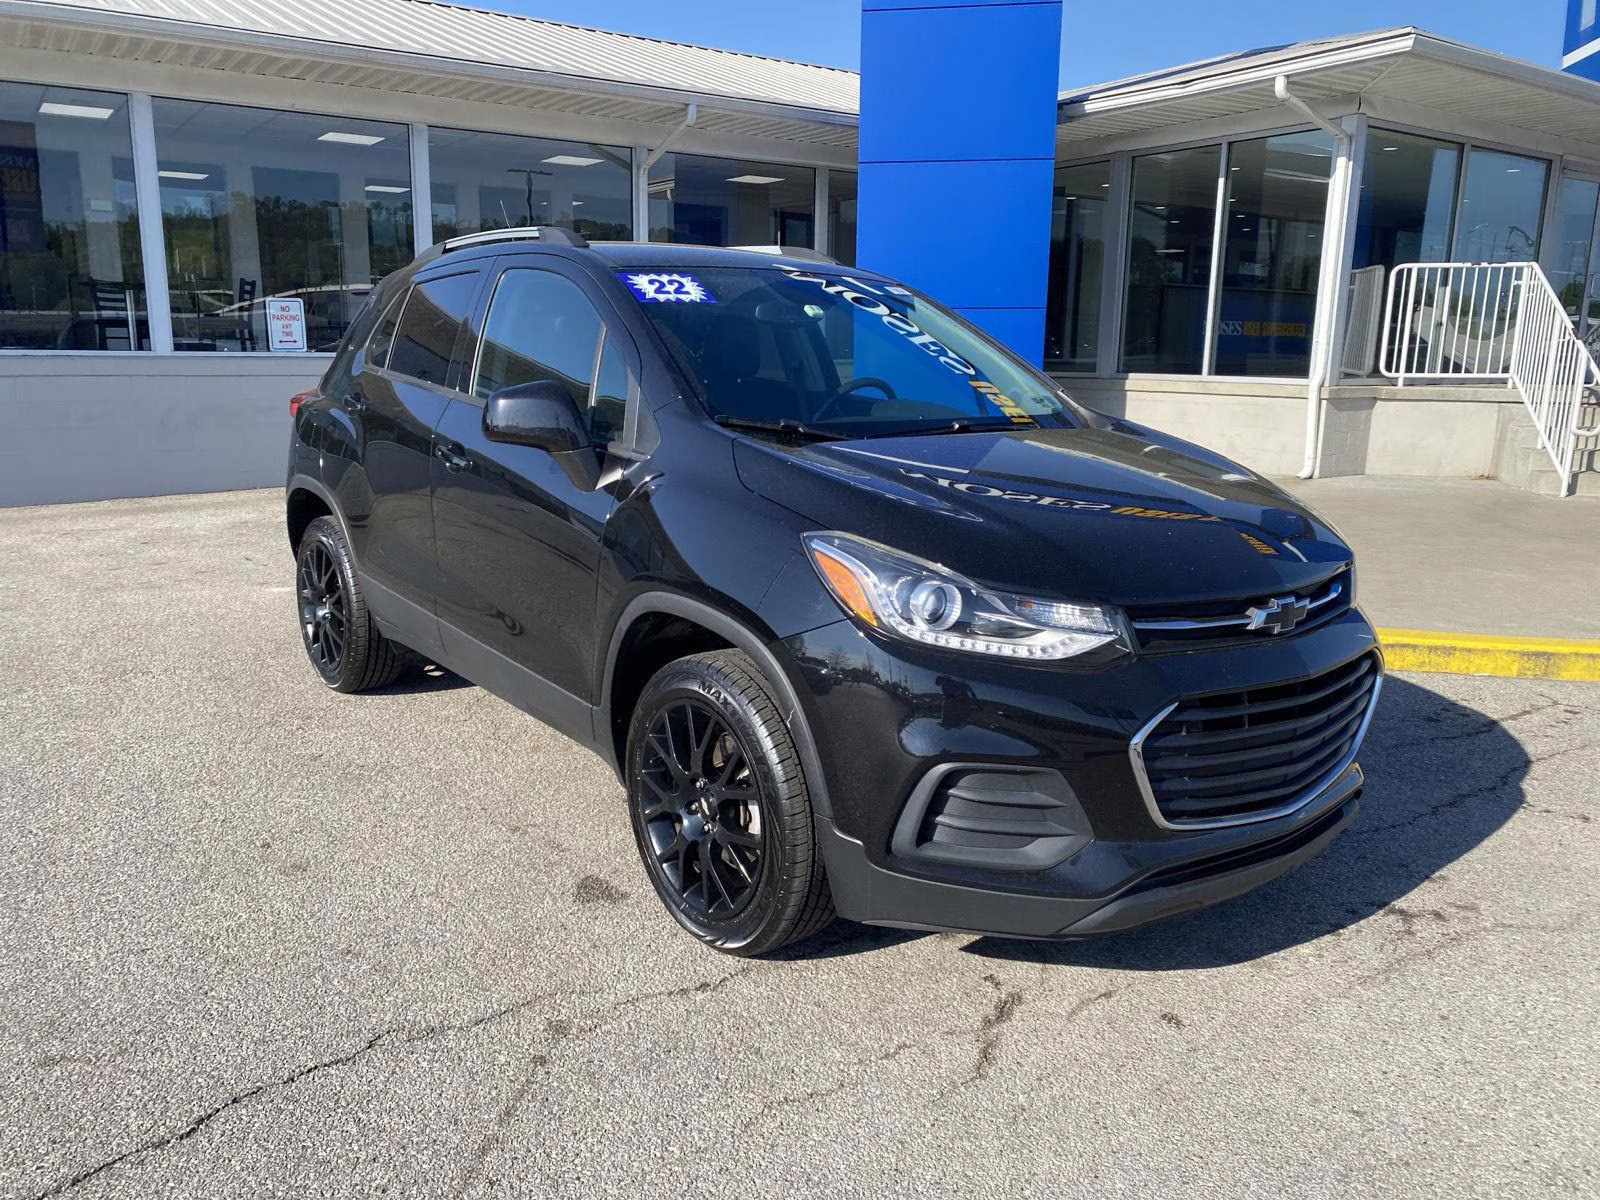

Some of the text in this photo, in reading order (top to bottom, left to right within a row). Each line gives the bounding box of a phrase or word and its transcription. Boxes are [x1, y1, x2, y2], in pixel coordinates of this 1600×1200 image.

[647, 278, 691, 295] 22
[280, 305, 290, 313] NO
[272, 314, 300, 322] PARKING
[282, 330, 294, 338] TIME
[698, 680, 734, 711] MAX
